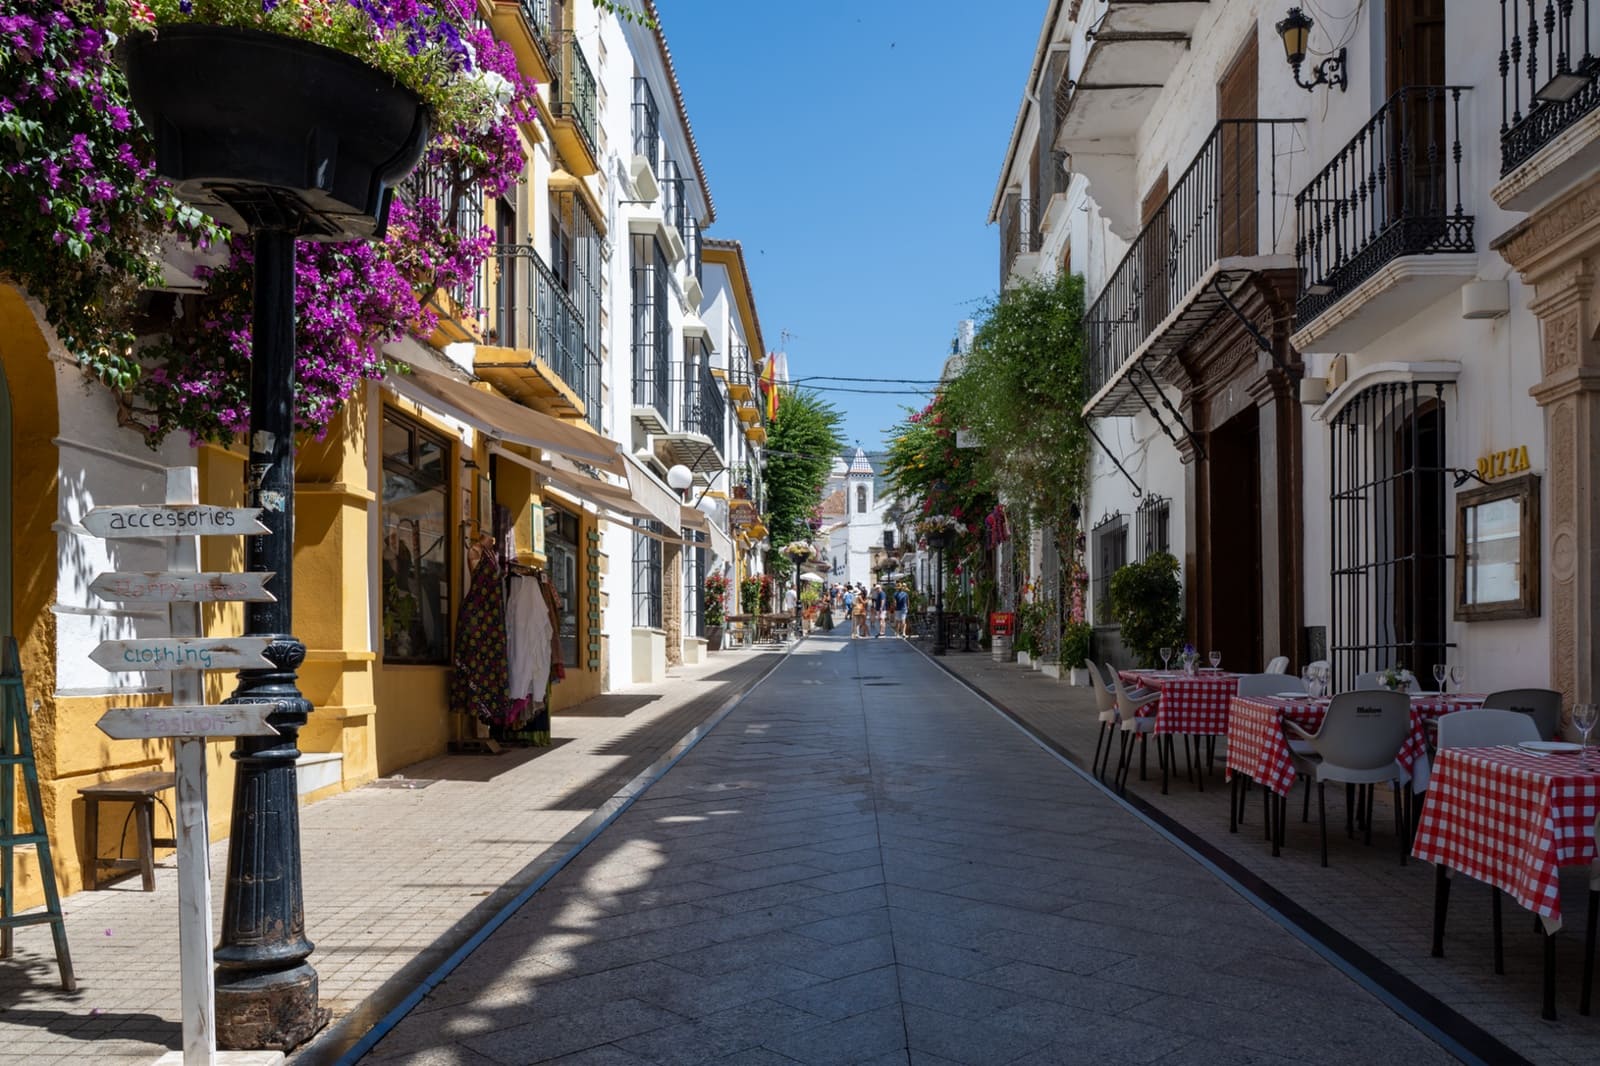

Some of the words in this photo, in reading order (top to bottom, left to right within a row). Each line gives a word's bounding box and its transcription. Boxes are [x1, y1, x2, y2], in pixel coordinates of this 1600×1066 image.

[1476, 445, 1530, 480] PIZZA
[110, 508, 235, 529] accessories
[123, 646, 212, 668] clothing
